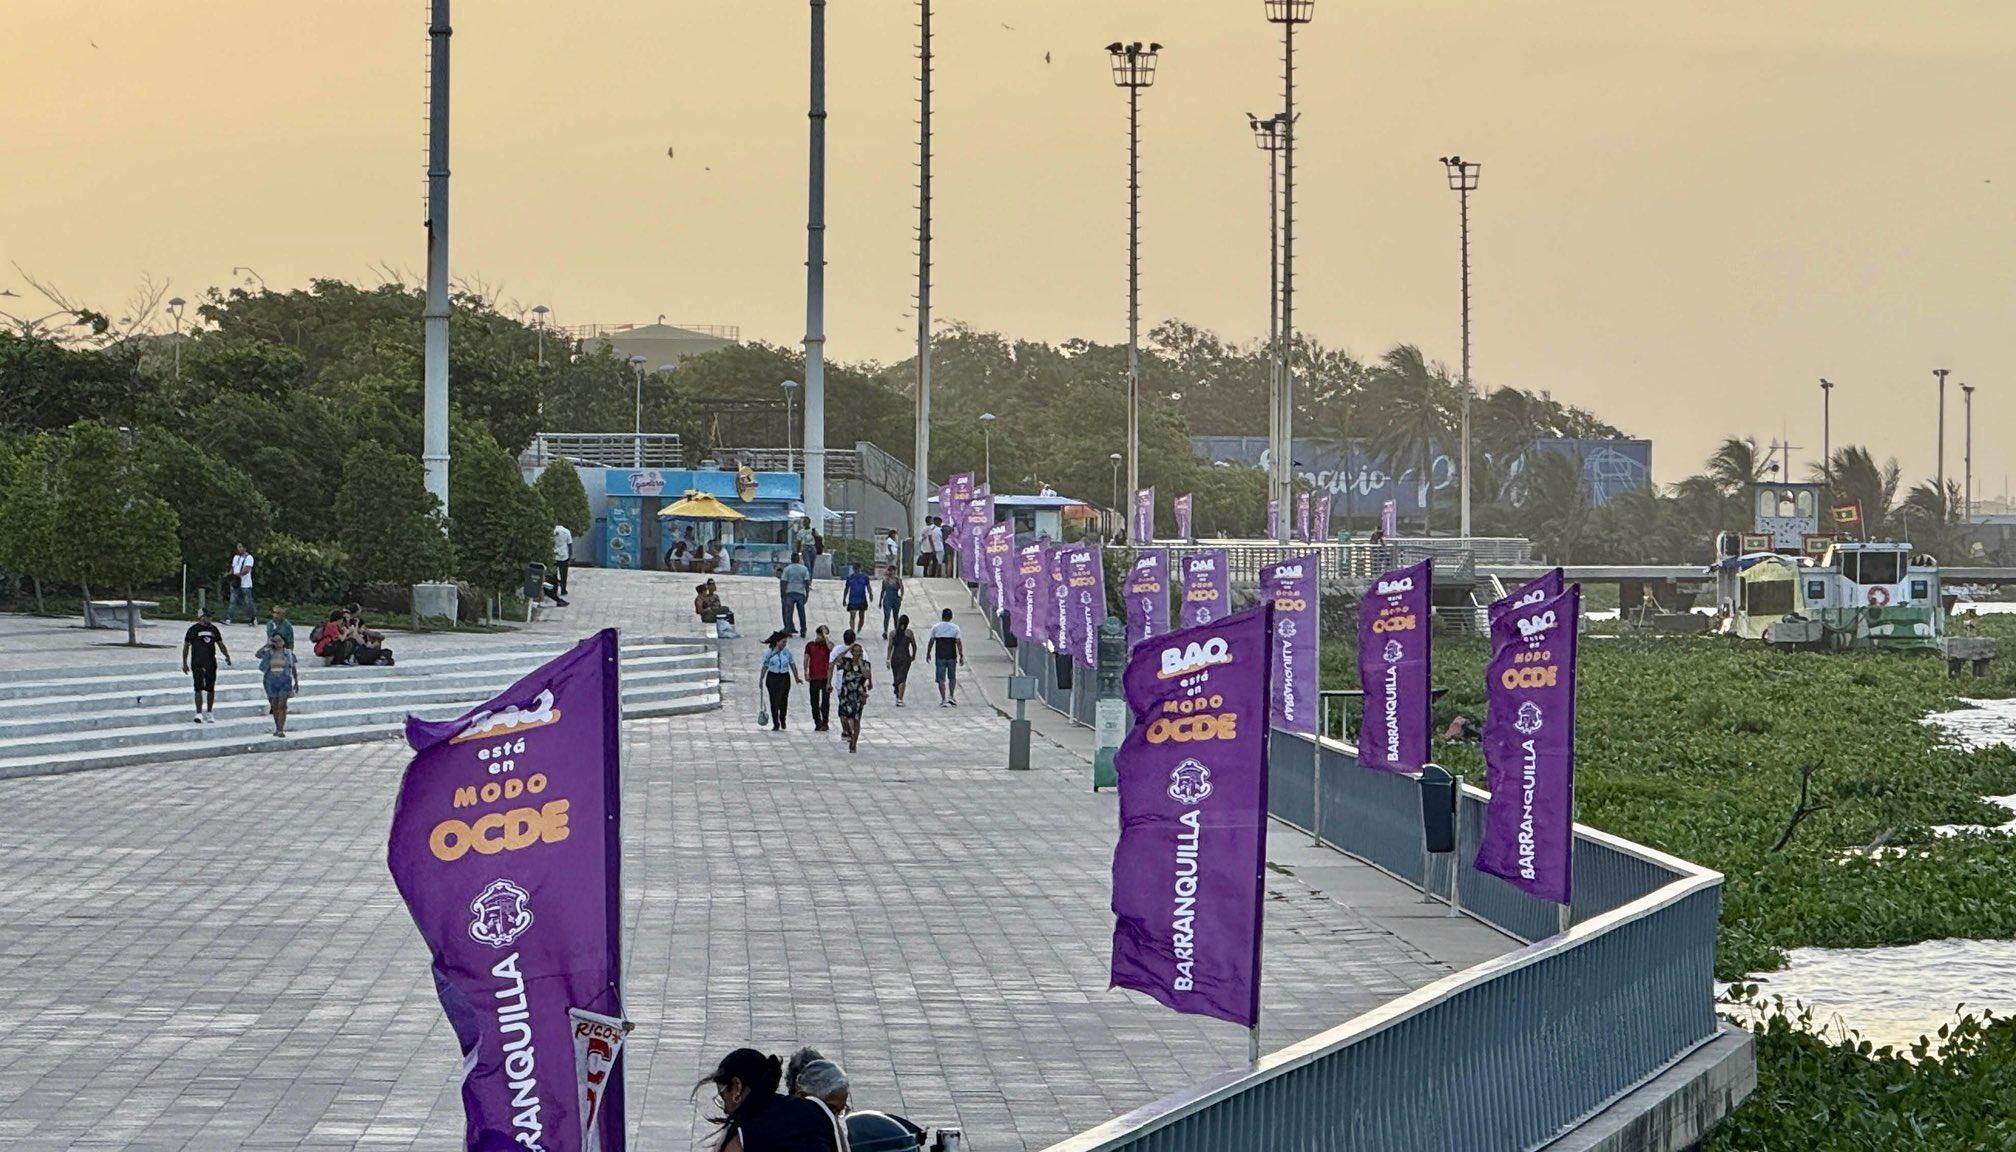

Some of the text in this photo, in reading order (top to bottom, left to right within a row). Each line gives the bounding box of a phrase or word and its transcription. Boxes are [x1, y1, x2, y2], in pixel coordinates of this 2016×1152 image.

[1377, 577, 1413, 594] BAQ
[1372, 614, 1416, 634] OCDE
[1517, 610, 1557, 637] BAQ
[1161, 637, 1229, 675] BAQ
[1514, 650, 1551, 664] MODO
[1180, 669, 1209, 688] está
[1501, 665, 1559, 690] OCDE
[1163, 694, 1224, 713] MODO
[1187, 685, 1202, 697] en
[1383, 665, 1399, 762] BARRANQUILLA
[1146, 712, 1238, 744] OCDE
[477, 738, 526, 761] está
[488, 760, 515, 775] en
[453, 773, 548, 809] MODO
[1512, 739, 1535, 880] BARRANQUILLA
[429, 799, 571, 862] OCDE
[1173, 809, 1201, 992] BARRANQUILLA
[491, 952, 547, 1152] RANQUILLA
